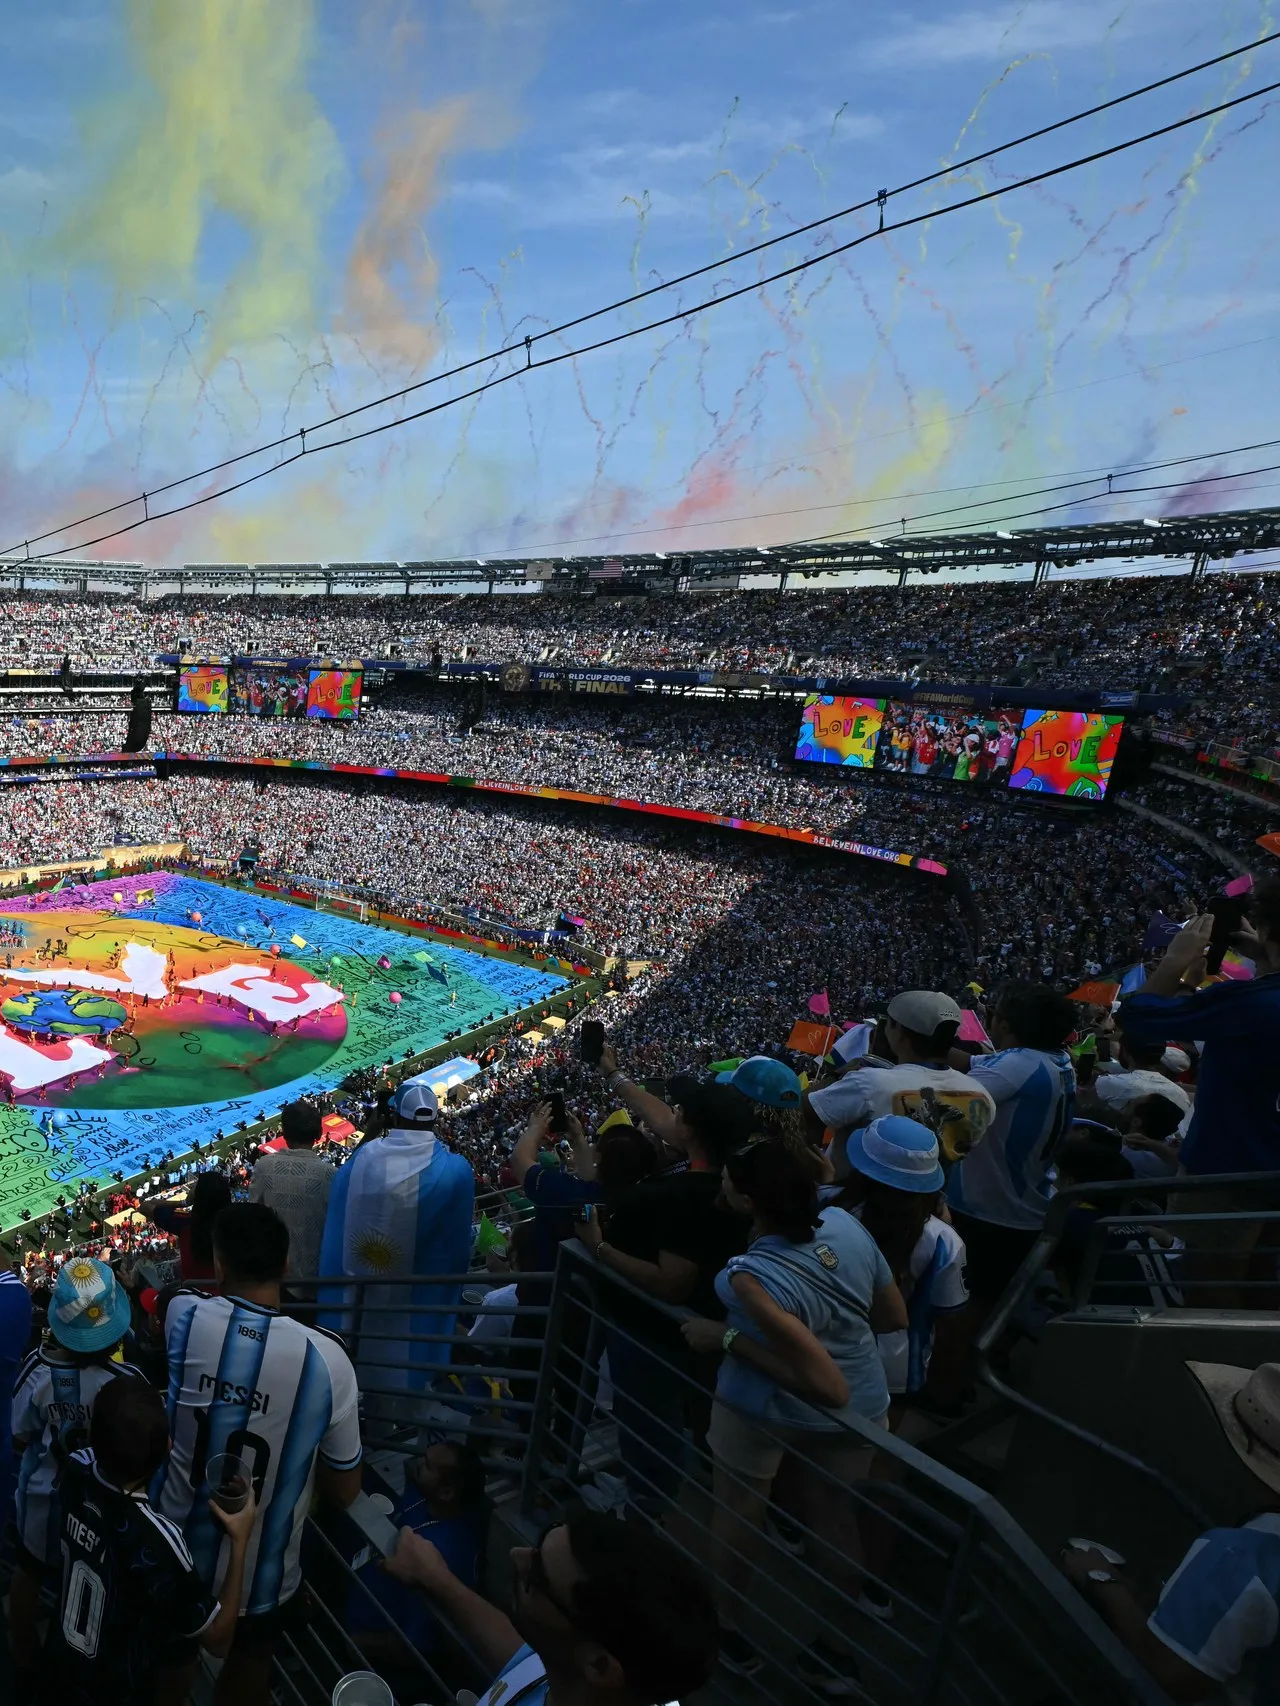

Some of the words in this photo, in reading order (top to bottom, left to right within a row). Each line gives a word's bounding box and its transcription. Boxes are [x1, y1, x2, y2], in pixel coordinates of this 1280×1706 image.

[539, 671, 556, 679] FIFA
[602, 674, 631, 682] 2026
[186, 678, 221, 697] LOVE
[316, 684, 352, 704] LOVE
[575, 680, 629, 694] FINAL
[813, 711, 869, 739] LOVE
[1032, 730, 1102, 764] LOVE
[475, 778, 542, 795] BELIEVEINLOVE.ORG
[813, 836, 900, 863] BELIEVEINLOVE.ORG
[238, 1324, 264, 1342] 1893
[59, 1377, 76, 1388] 1893
[199, 1373, 269, 1414] MESSI
[48, 1402, 91, 1421] MESSI
